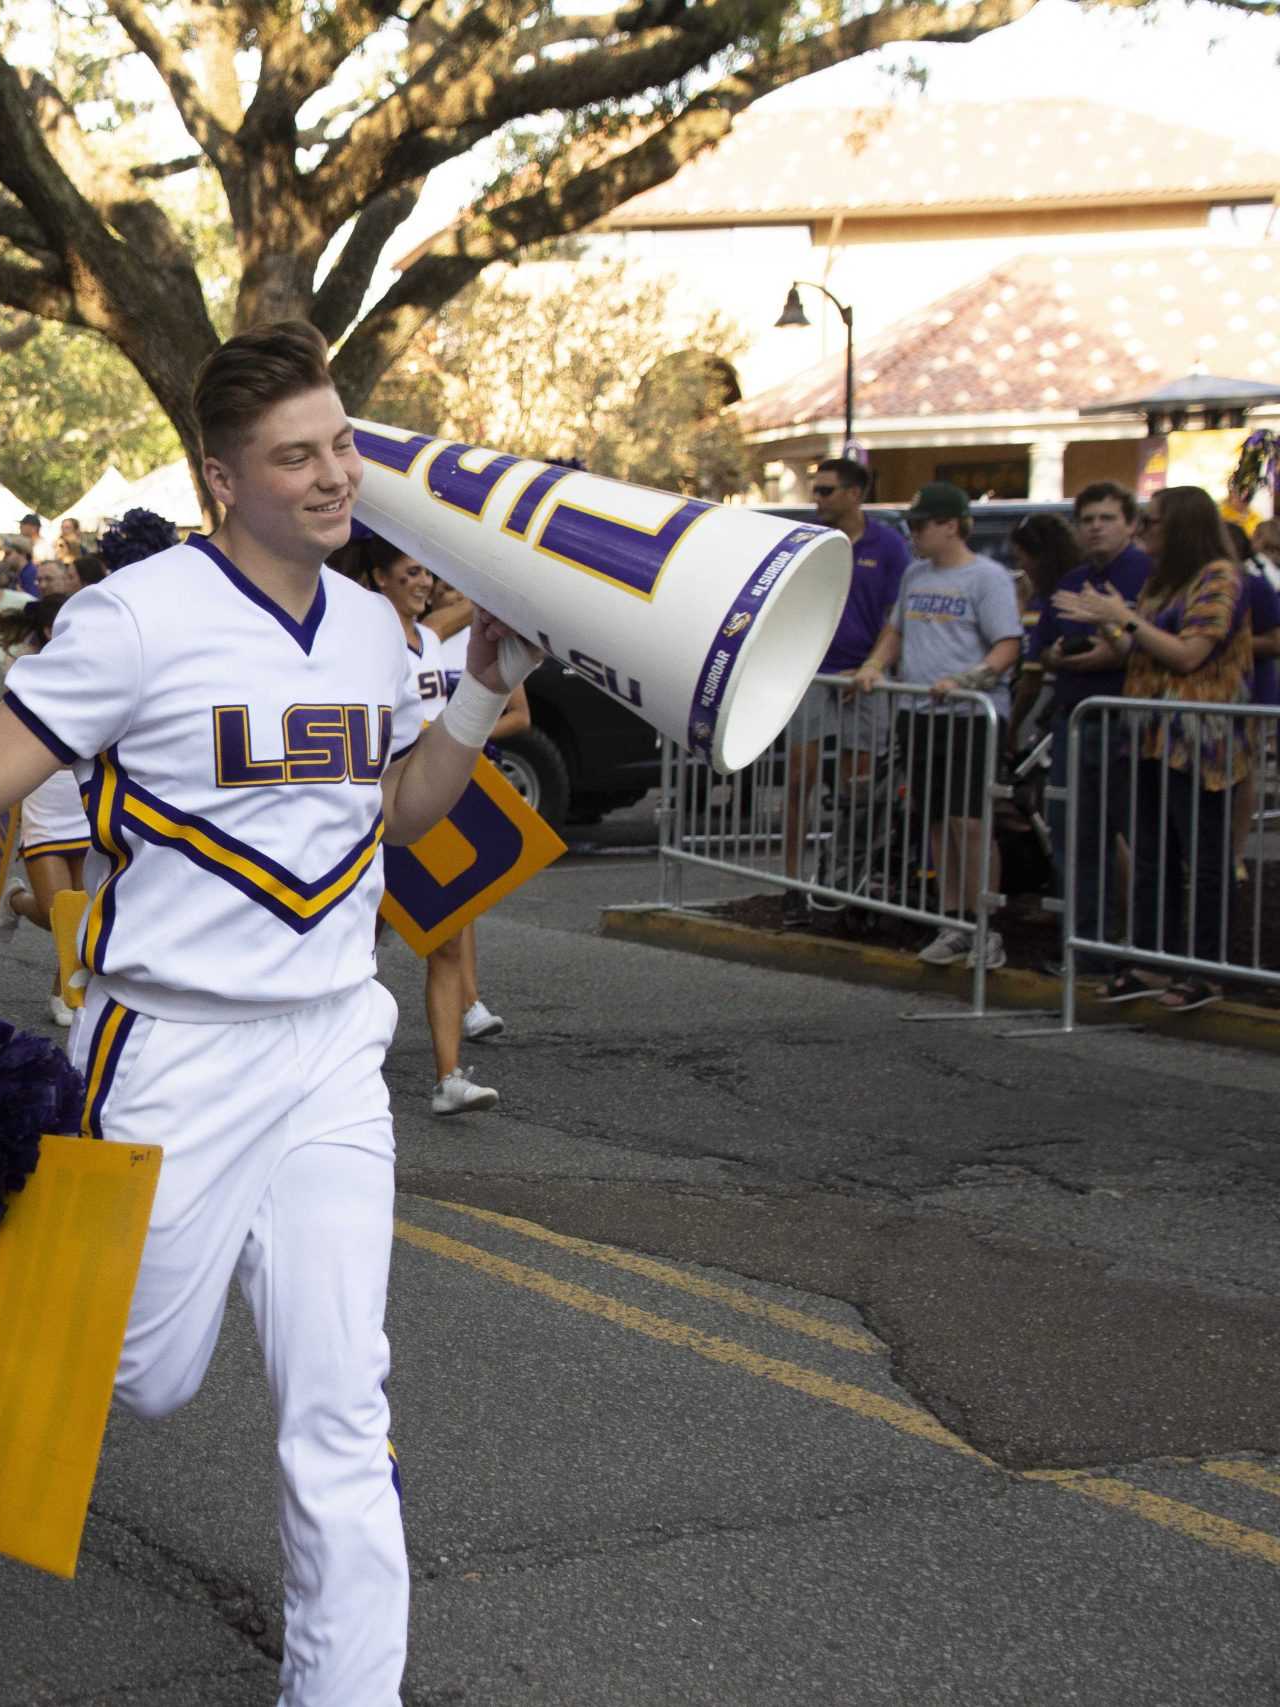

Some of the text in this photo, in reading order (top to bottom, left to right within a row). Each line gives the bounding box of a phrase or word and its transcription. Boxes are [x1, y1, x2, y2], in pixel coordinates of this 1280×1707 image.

[751, 551, 793, 597] #LSUROAR
[701, 649, 731, 708] #LSUROAR
[212, 703, 393, 788] LSU
